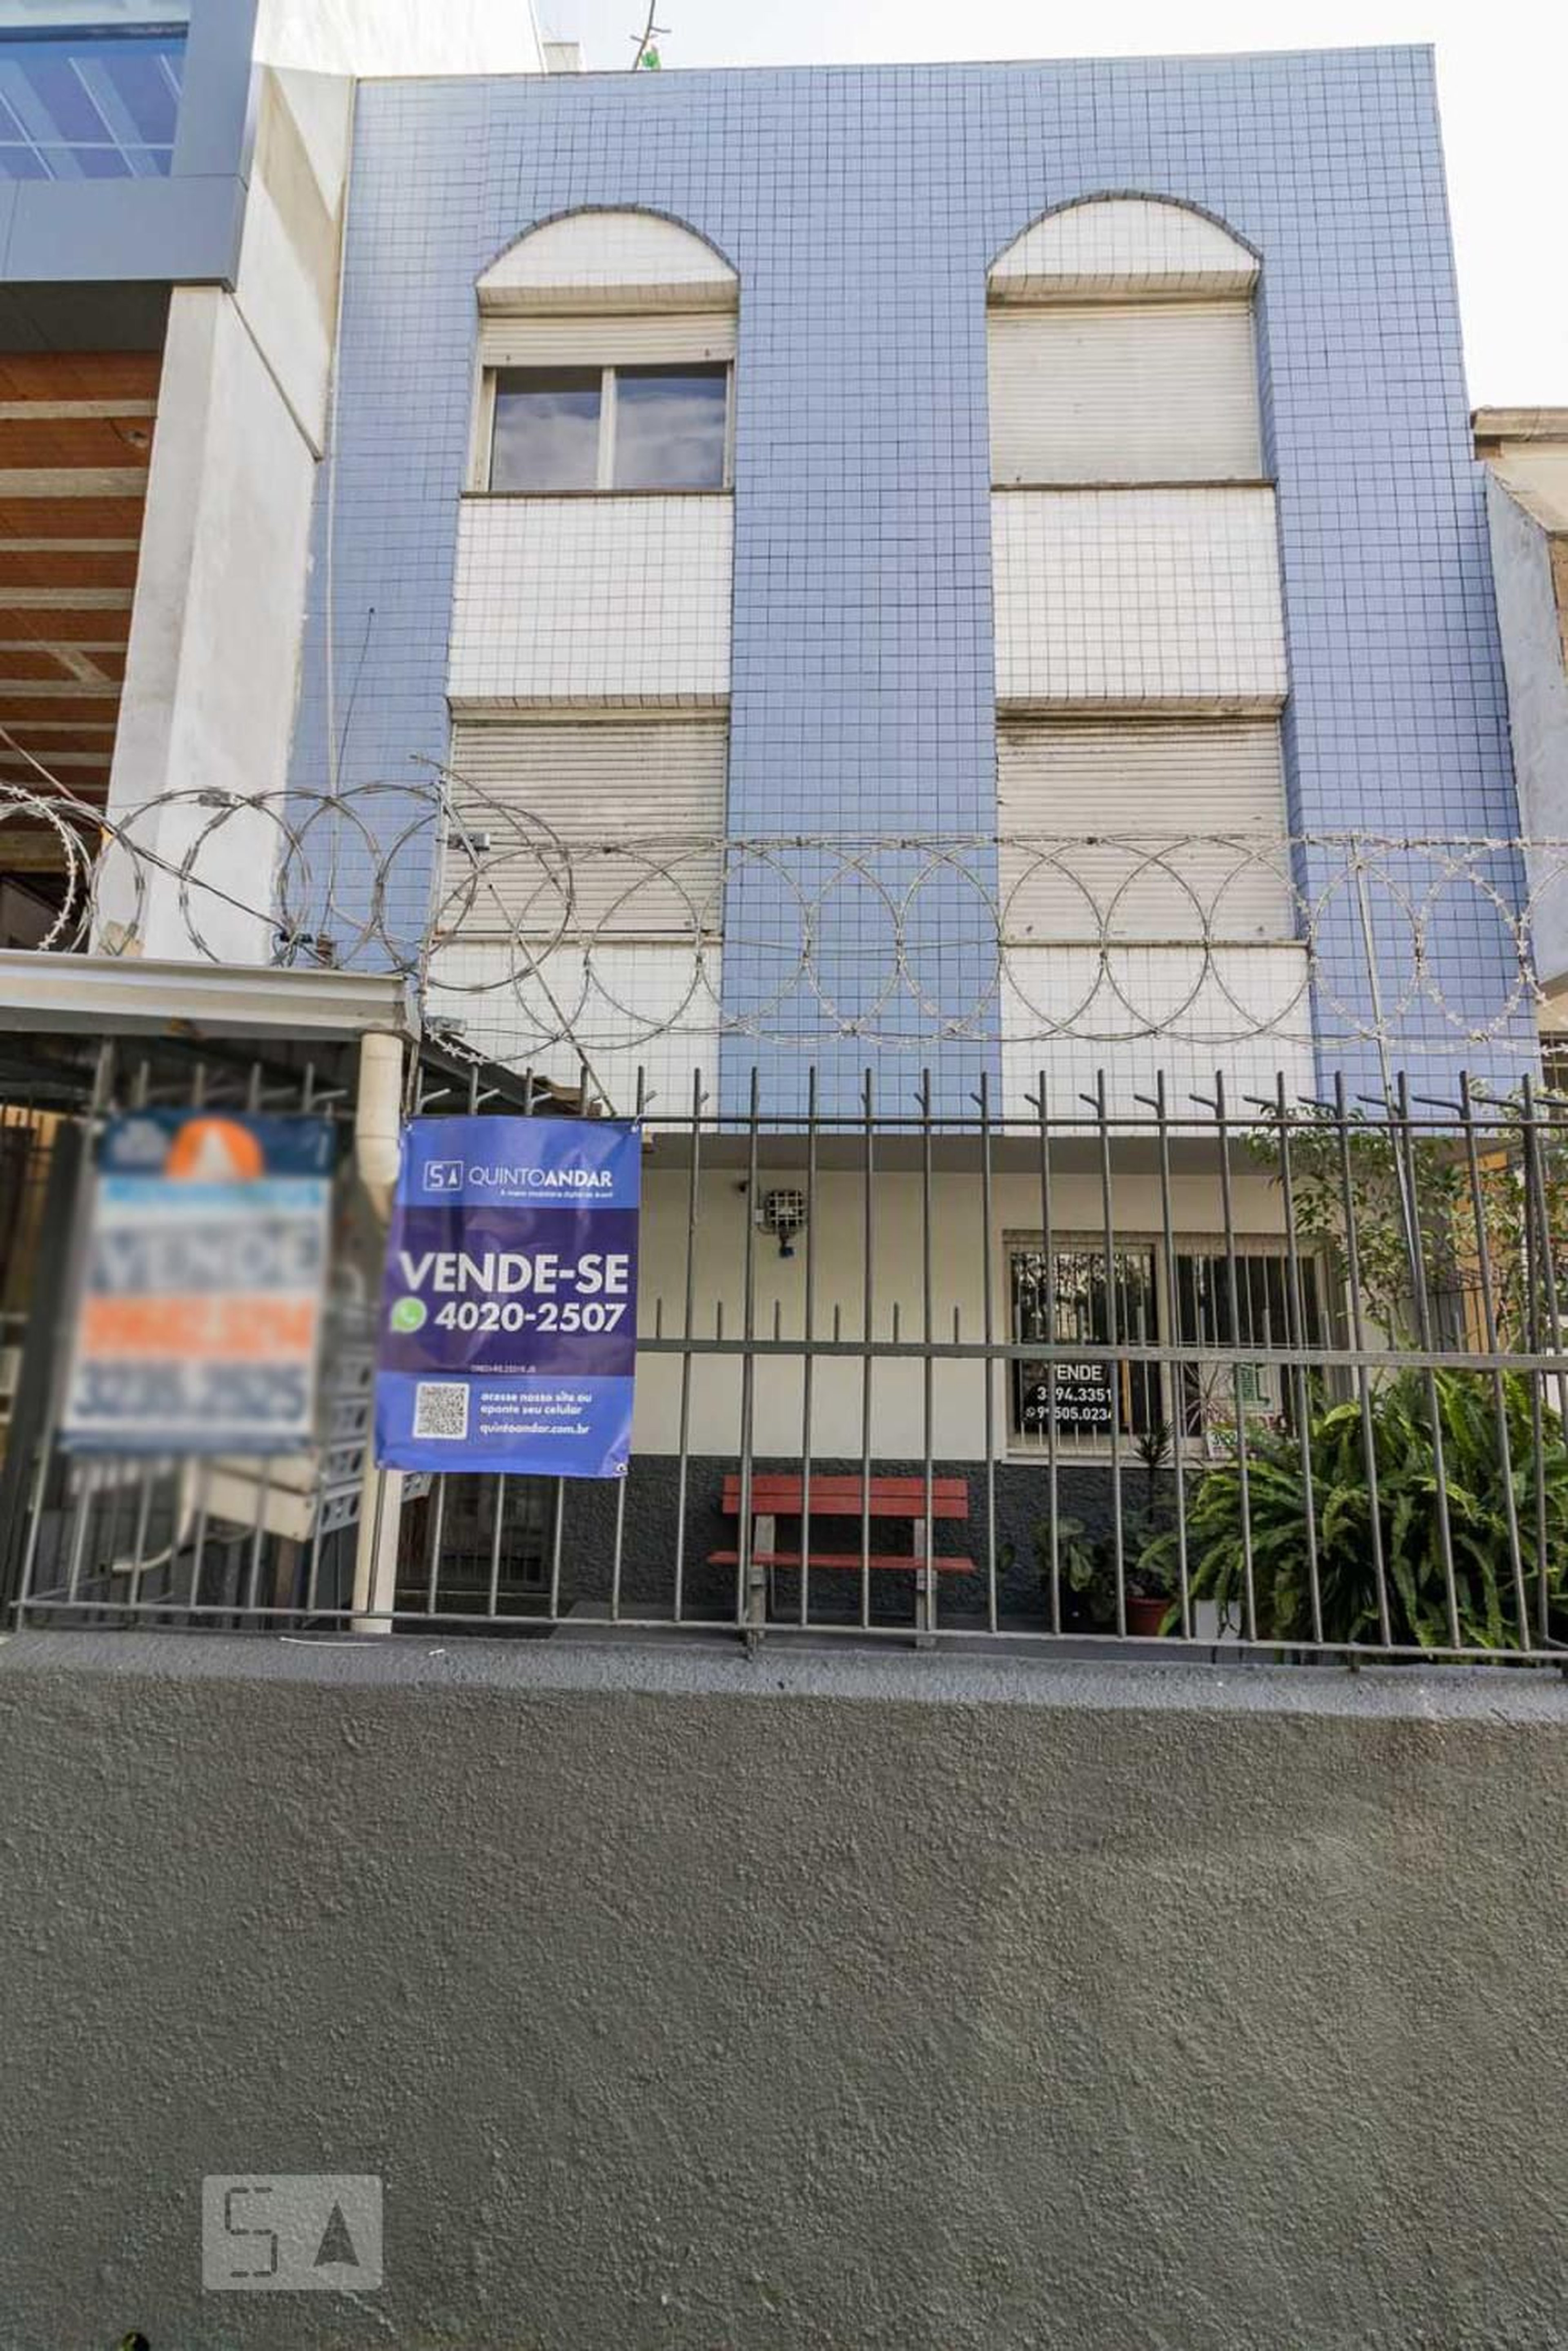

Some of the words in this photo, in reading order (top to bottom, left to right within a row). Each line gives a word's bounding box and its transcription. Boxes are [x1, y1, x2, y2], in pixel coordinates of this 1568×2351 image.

[469, 1166, 612, 1187] QUINTOANDAR
[399, 1252, 629, 1294] VENDE-SE
[434, 1301, 626, 1332] 4020-2507
[1037, 1386, 1111, 1402] 394.3351
